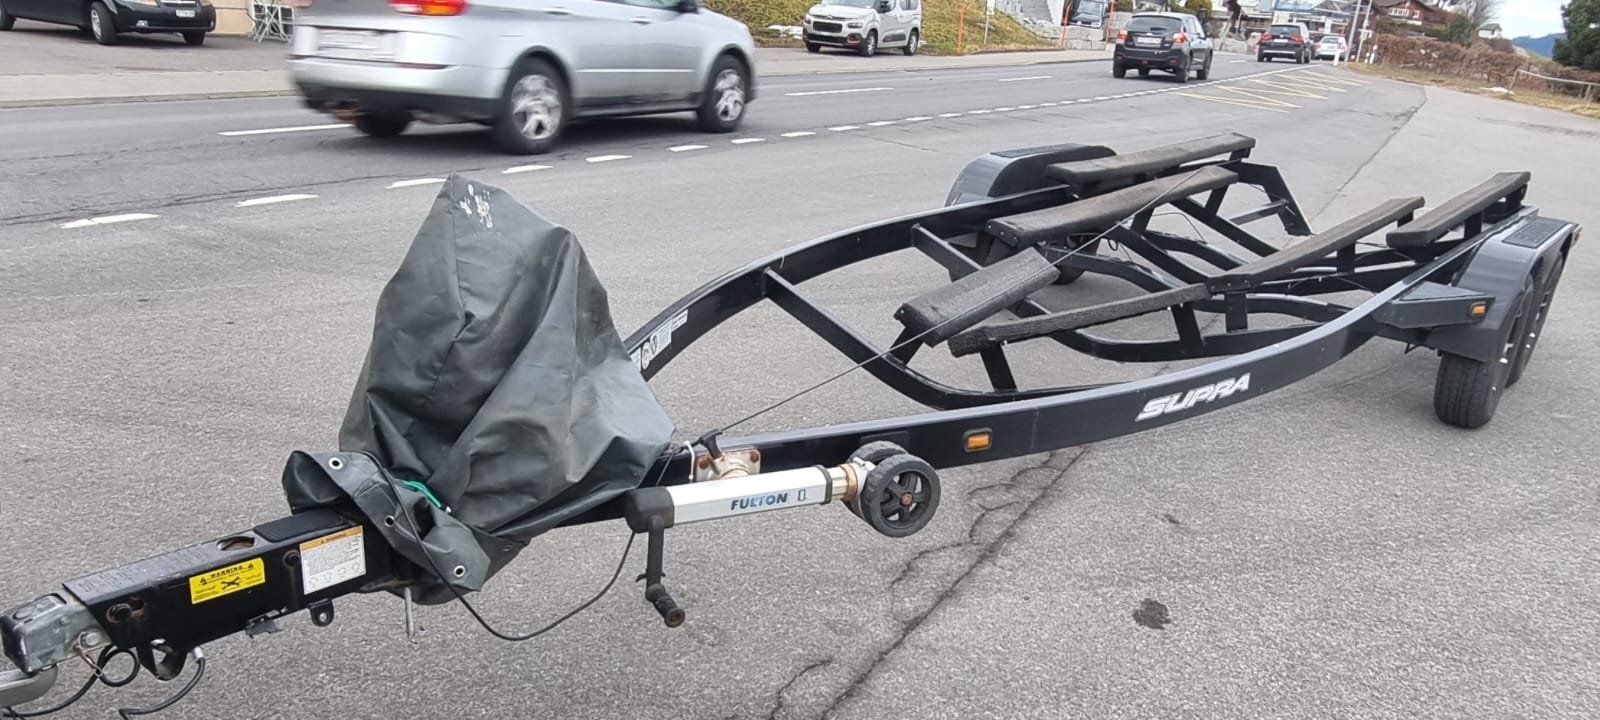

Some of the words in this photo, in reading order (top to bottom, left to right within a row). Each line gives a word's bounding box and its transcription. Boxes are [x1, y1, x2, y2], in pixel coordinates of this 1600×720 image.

[1134, 372, 1251, 422] SUPRA
[730, 493, 788, 511] FULTON
[210, 565, 243, 578] WARNING
